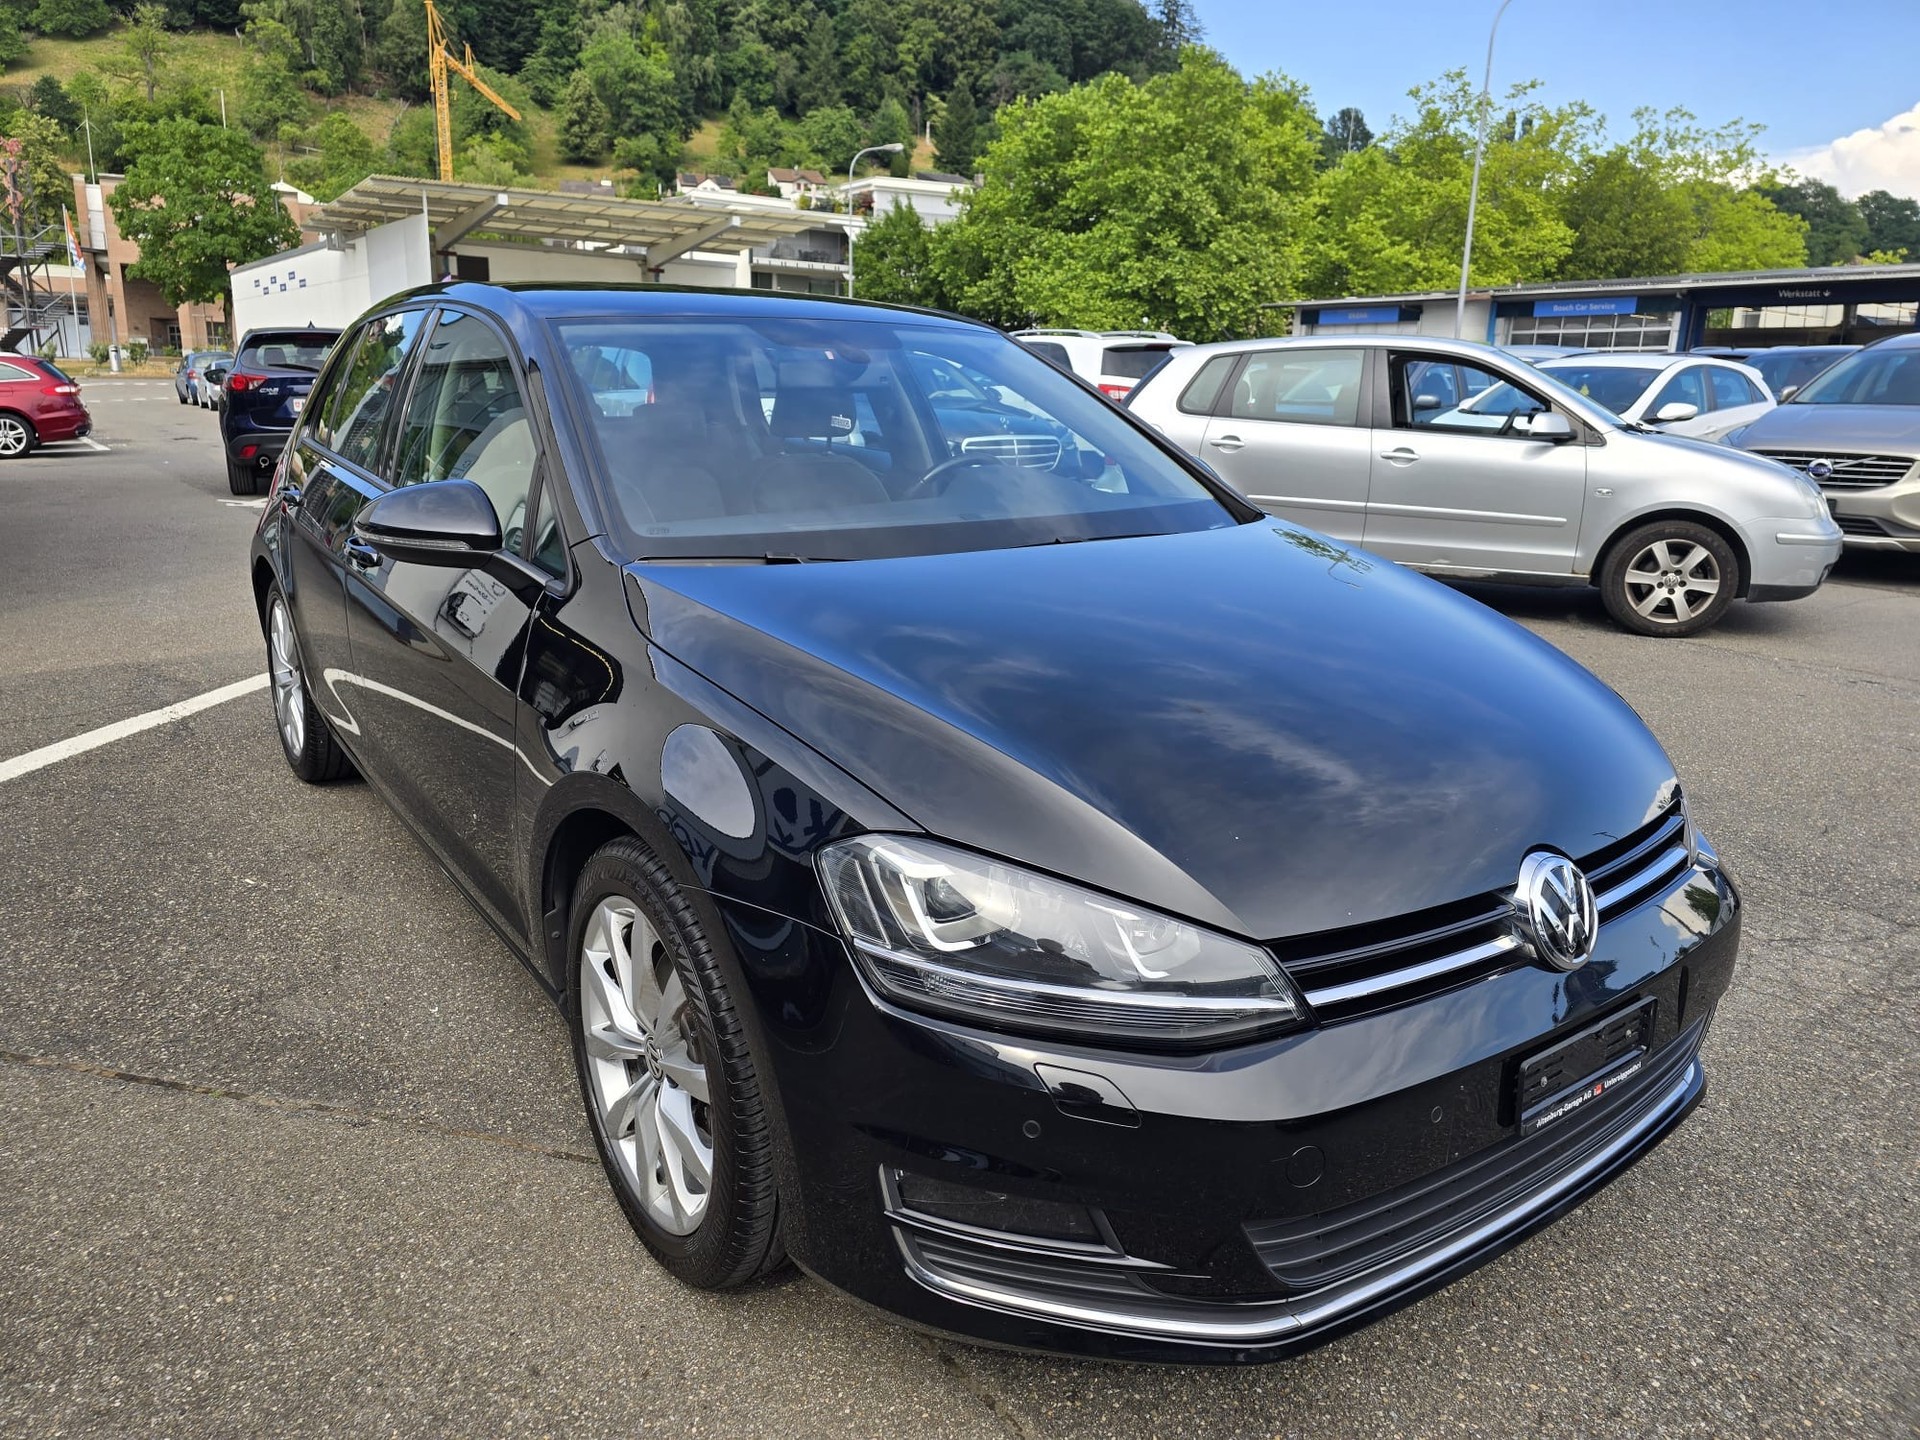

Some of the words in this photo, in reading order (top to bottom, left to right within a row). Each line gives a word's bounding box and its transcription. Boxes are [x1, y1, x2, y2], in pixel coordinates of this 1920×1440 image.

[1778, 289, 1821, 298] Werkstatt
[1552, 304, 1574, 312] Bosch
[1575, 303, 1588, 311] Car
[1589, 302, 1616, 311] Service
[1583, 1090, 1592, 1101] AG
